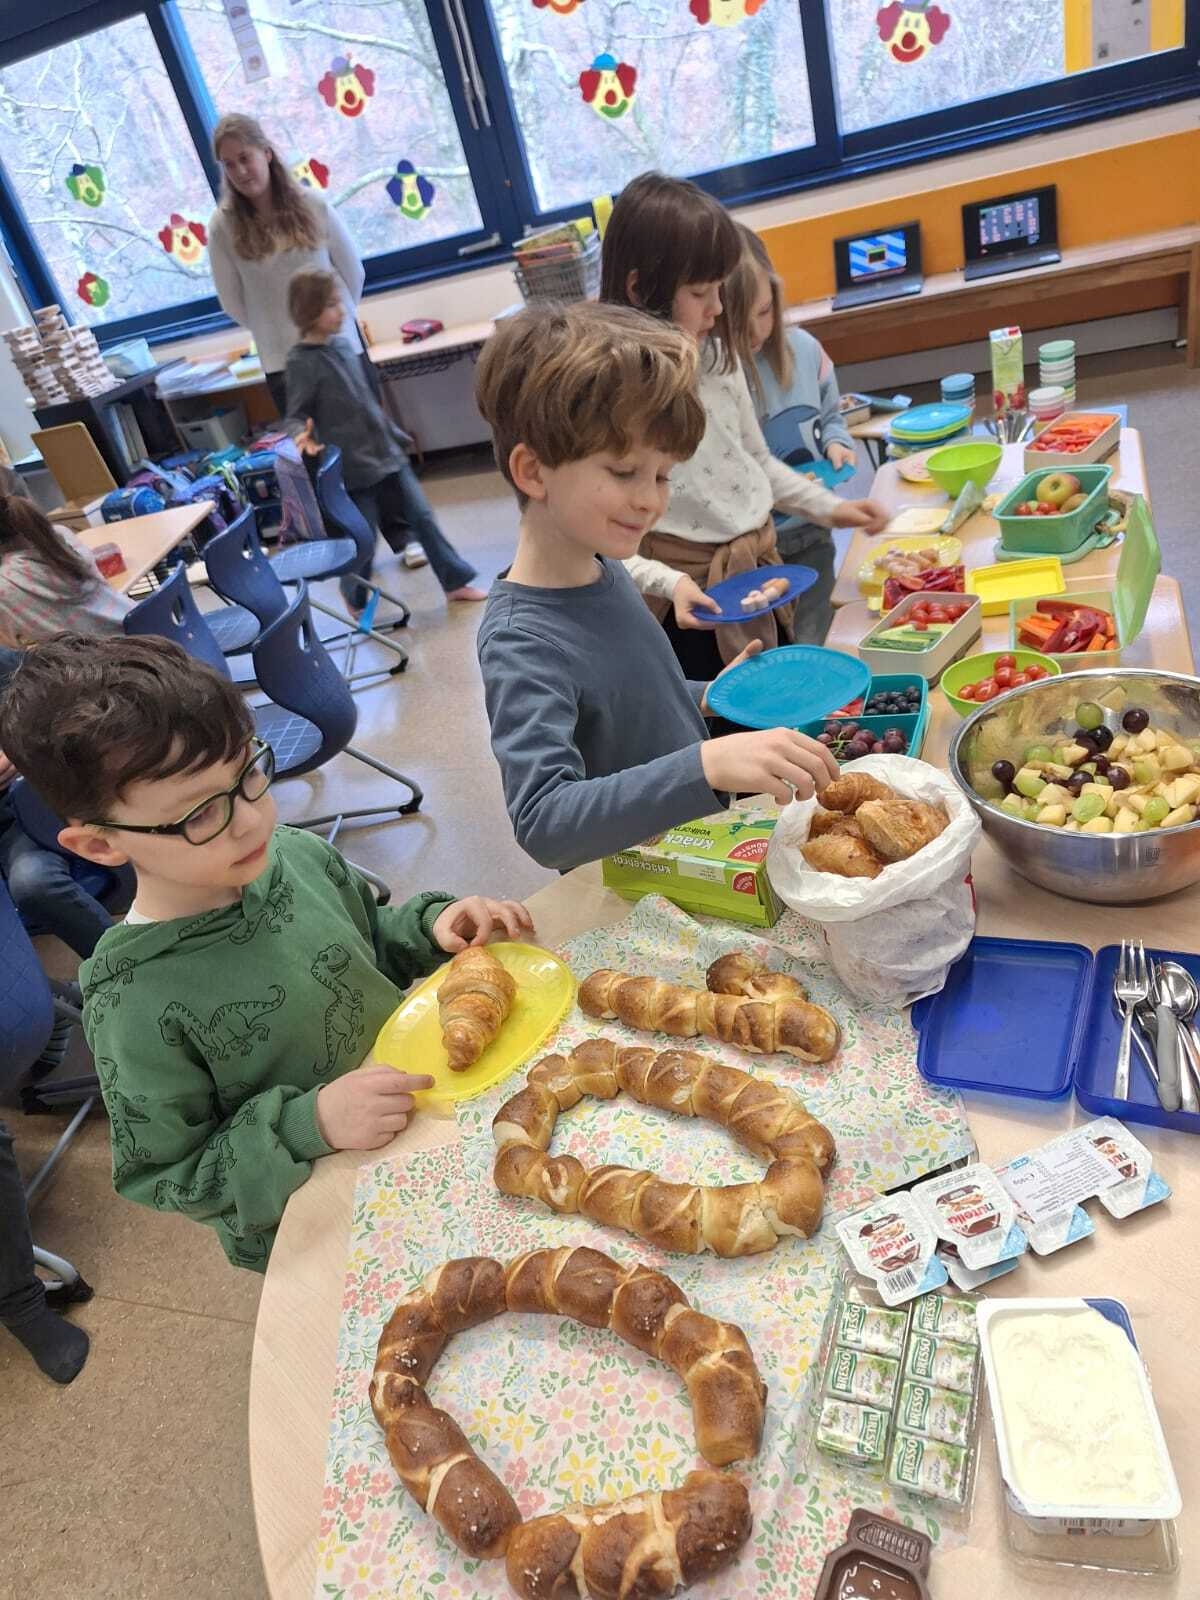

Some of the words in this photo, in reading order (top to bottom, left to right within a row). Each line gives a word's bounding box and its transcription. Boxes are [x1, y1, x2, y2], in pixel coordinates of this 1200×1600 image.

[947, 1202, 996, 1227] nutella
[868, 1232, 915, 1260] nutella
[846, 1304, 862, 1341] BRESSO
[922, 1294, 938, 1330] BRESSO
[835, 1352, 851, 1390] BRESSO
[917, 1337, 932, 1376] BRESSO
[910, 1387, 925, 1427] BRESSO
[864, 1414, 881, 1453] BRESSO
[902, 1438, 918, 1481] BRESSO
